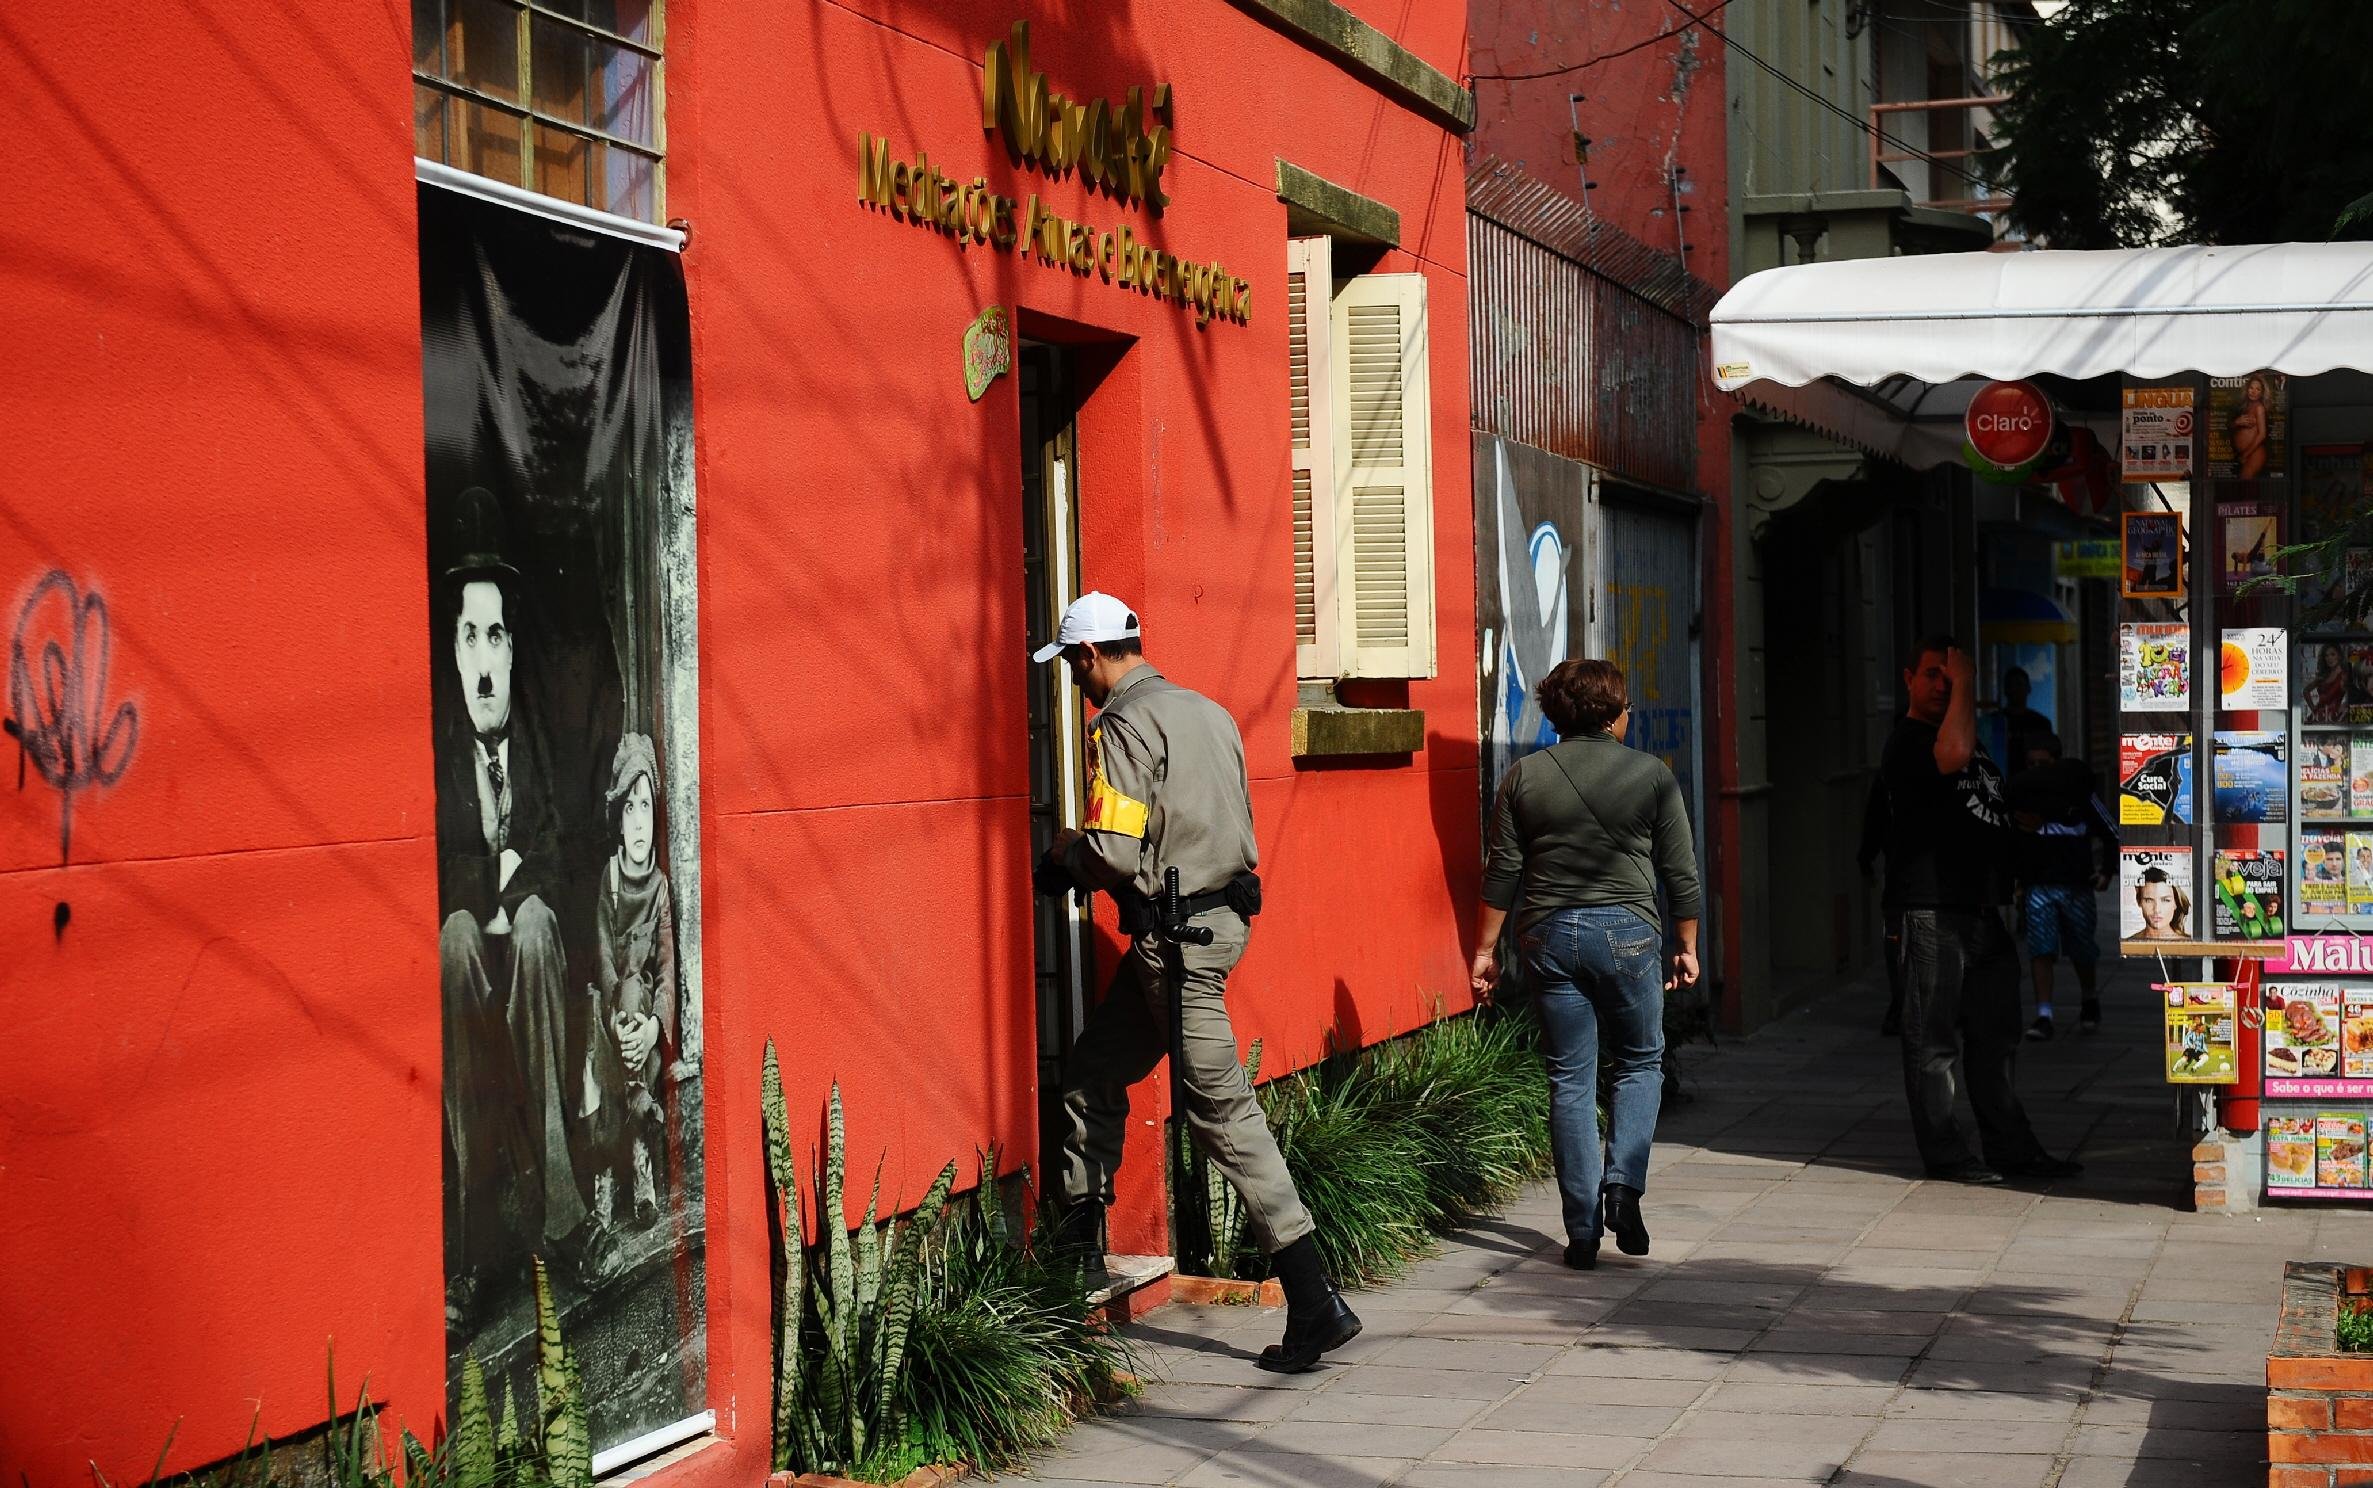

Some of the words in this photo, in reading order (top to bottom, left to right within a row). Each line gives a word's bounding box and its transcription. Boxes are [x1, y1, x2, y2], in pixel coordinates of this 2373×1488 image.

[2210, 377, 2249, 388] conti
[1976, 413, 2032, 432] Claro
[2133, 415, 2164, 425] ponto
[2252, 647, 2283, 655] HORAS
[2140, 774, 2164, 782] Cura
[2138, 781, 2167, 791] Social
[2122, 852, 2173, 866] mente
[2238, 858, 2282, 880] veja
[2280, 985, 2335, 998] Cozinha
[2272, 1081, 2300, 1093] Sabe
[2303, 1085, 2311, 1093] o
[2313, 1085, 2334, 1096] que
[2337, 1081, 2344, 1093] é
[2346, 1085, 2363, 1093] ser
